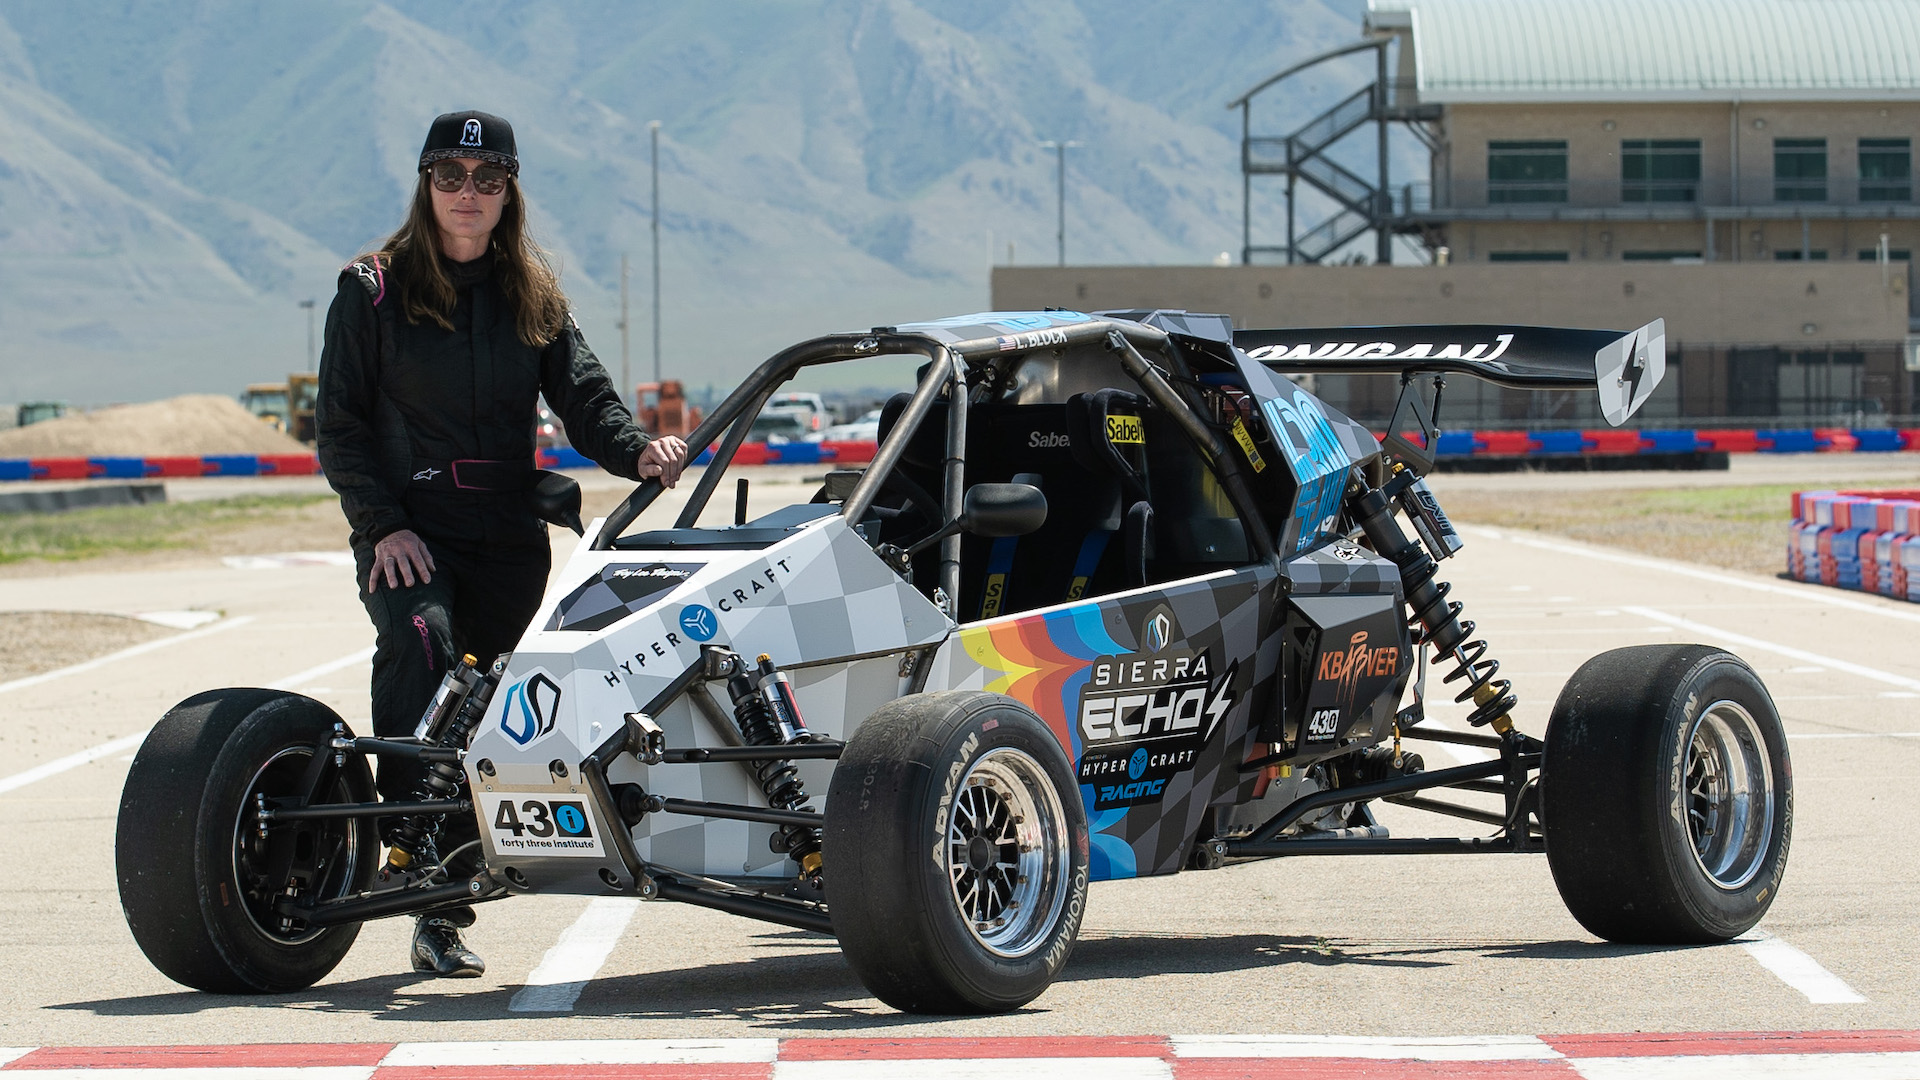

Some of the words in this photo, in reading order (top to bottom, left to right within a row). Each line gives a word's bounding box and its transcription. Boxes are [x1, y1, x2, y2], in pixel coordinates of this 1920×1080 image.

[1016, 335, 1028, 350] L.
[1028, 329, 1068, 348] BLOCK
[1028, 430, 1071, 448] Sabe
[983, 583, 1002, 619] Sa
[603, 632, 681, 689] HYPER
[718, 559, 791, 612] CRAFT
[1095, 655, 1208, 686] SIERRA
[1081, 687, 1208, 740] ECHO
[1082, 759, 1127, 777] HYPER
[1150, 750, 1194, 768] CRAFT
[932, 731, 980, 872] ADVAN
[1100, 778, 1166, 802] RACING
[501, 838, 525, 849] forty
[526, 839, 552, 848] three
[553, 839, 593, 849] institute
[1044, 864, 1088, 969] YOKOHAMA
